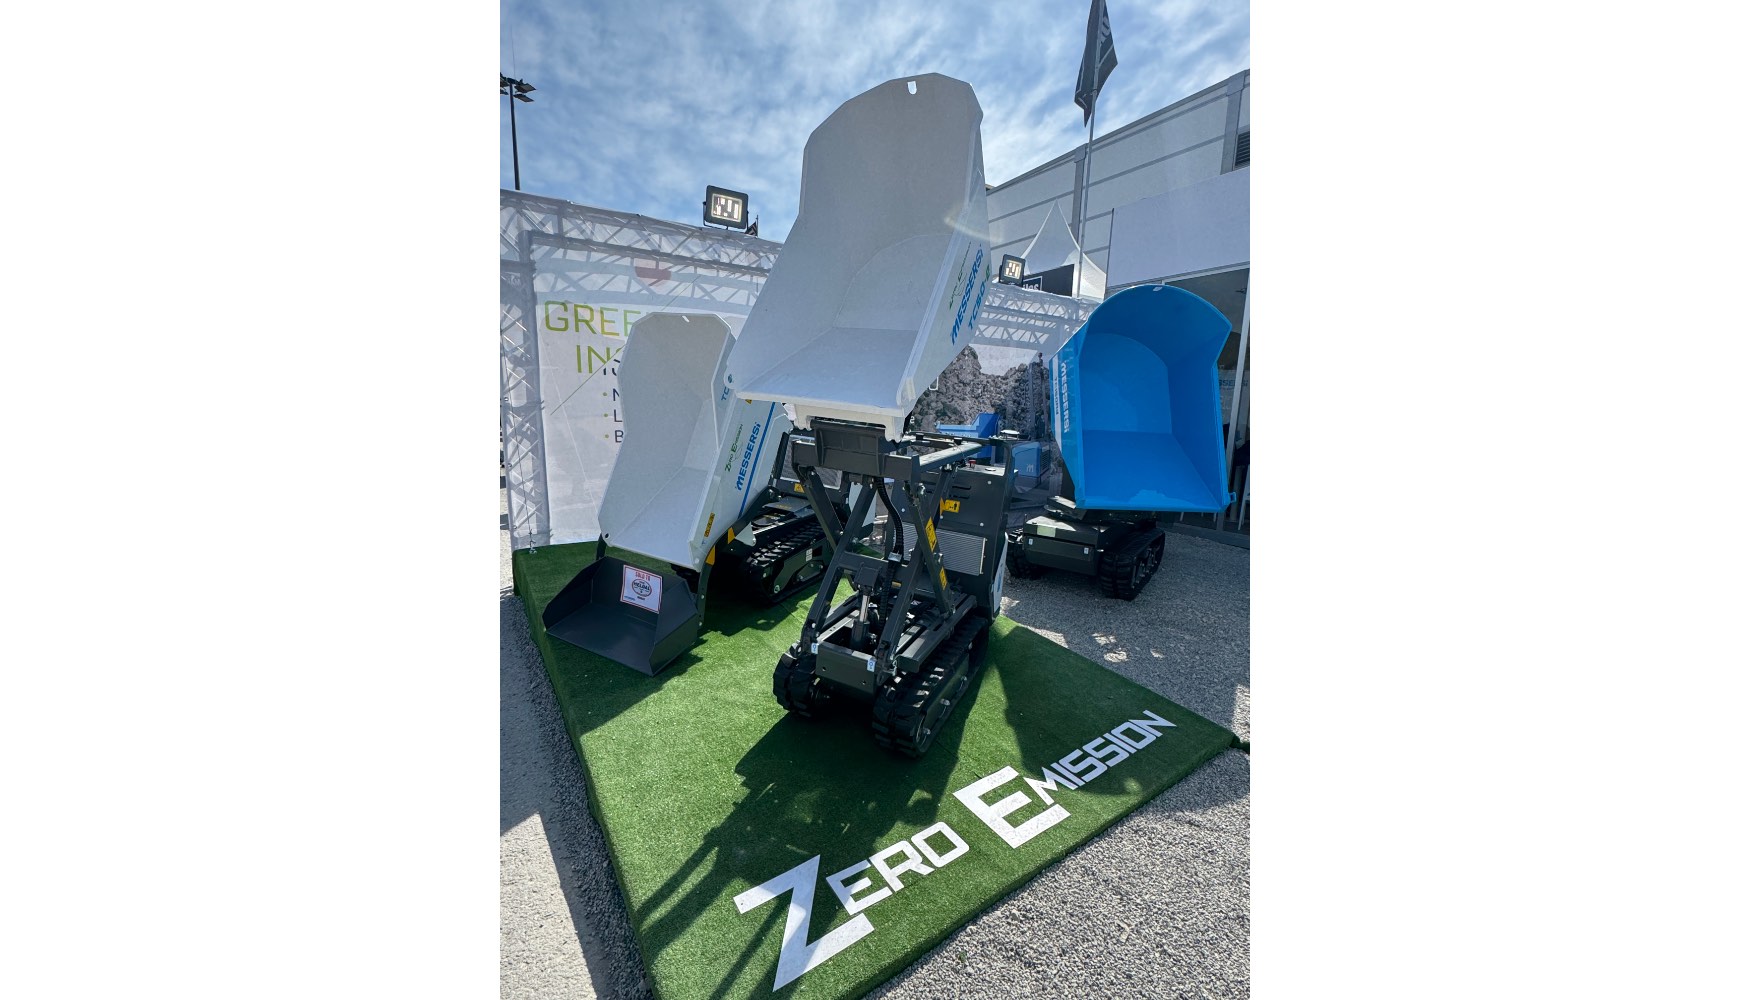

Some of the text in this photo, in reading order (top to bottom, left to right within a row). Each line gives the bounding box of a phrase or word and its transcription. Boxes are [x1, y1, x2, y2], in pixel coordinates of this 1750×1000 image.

[544, 300, 648, 337] GREE
[733, 709, 1177, 992] ZERO EMISSION
